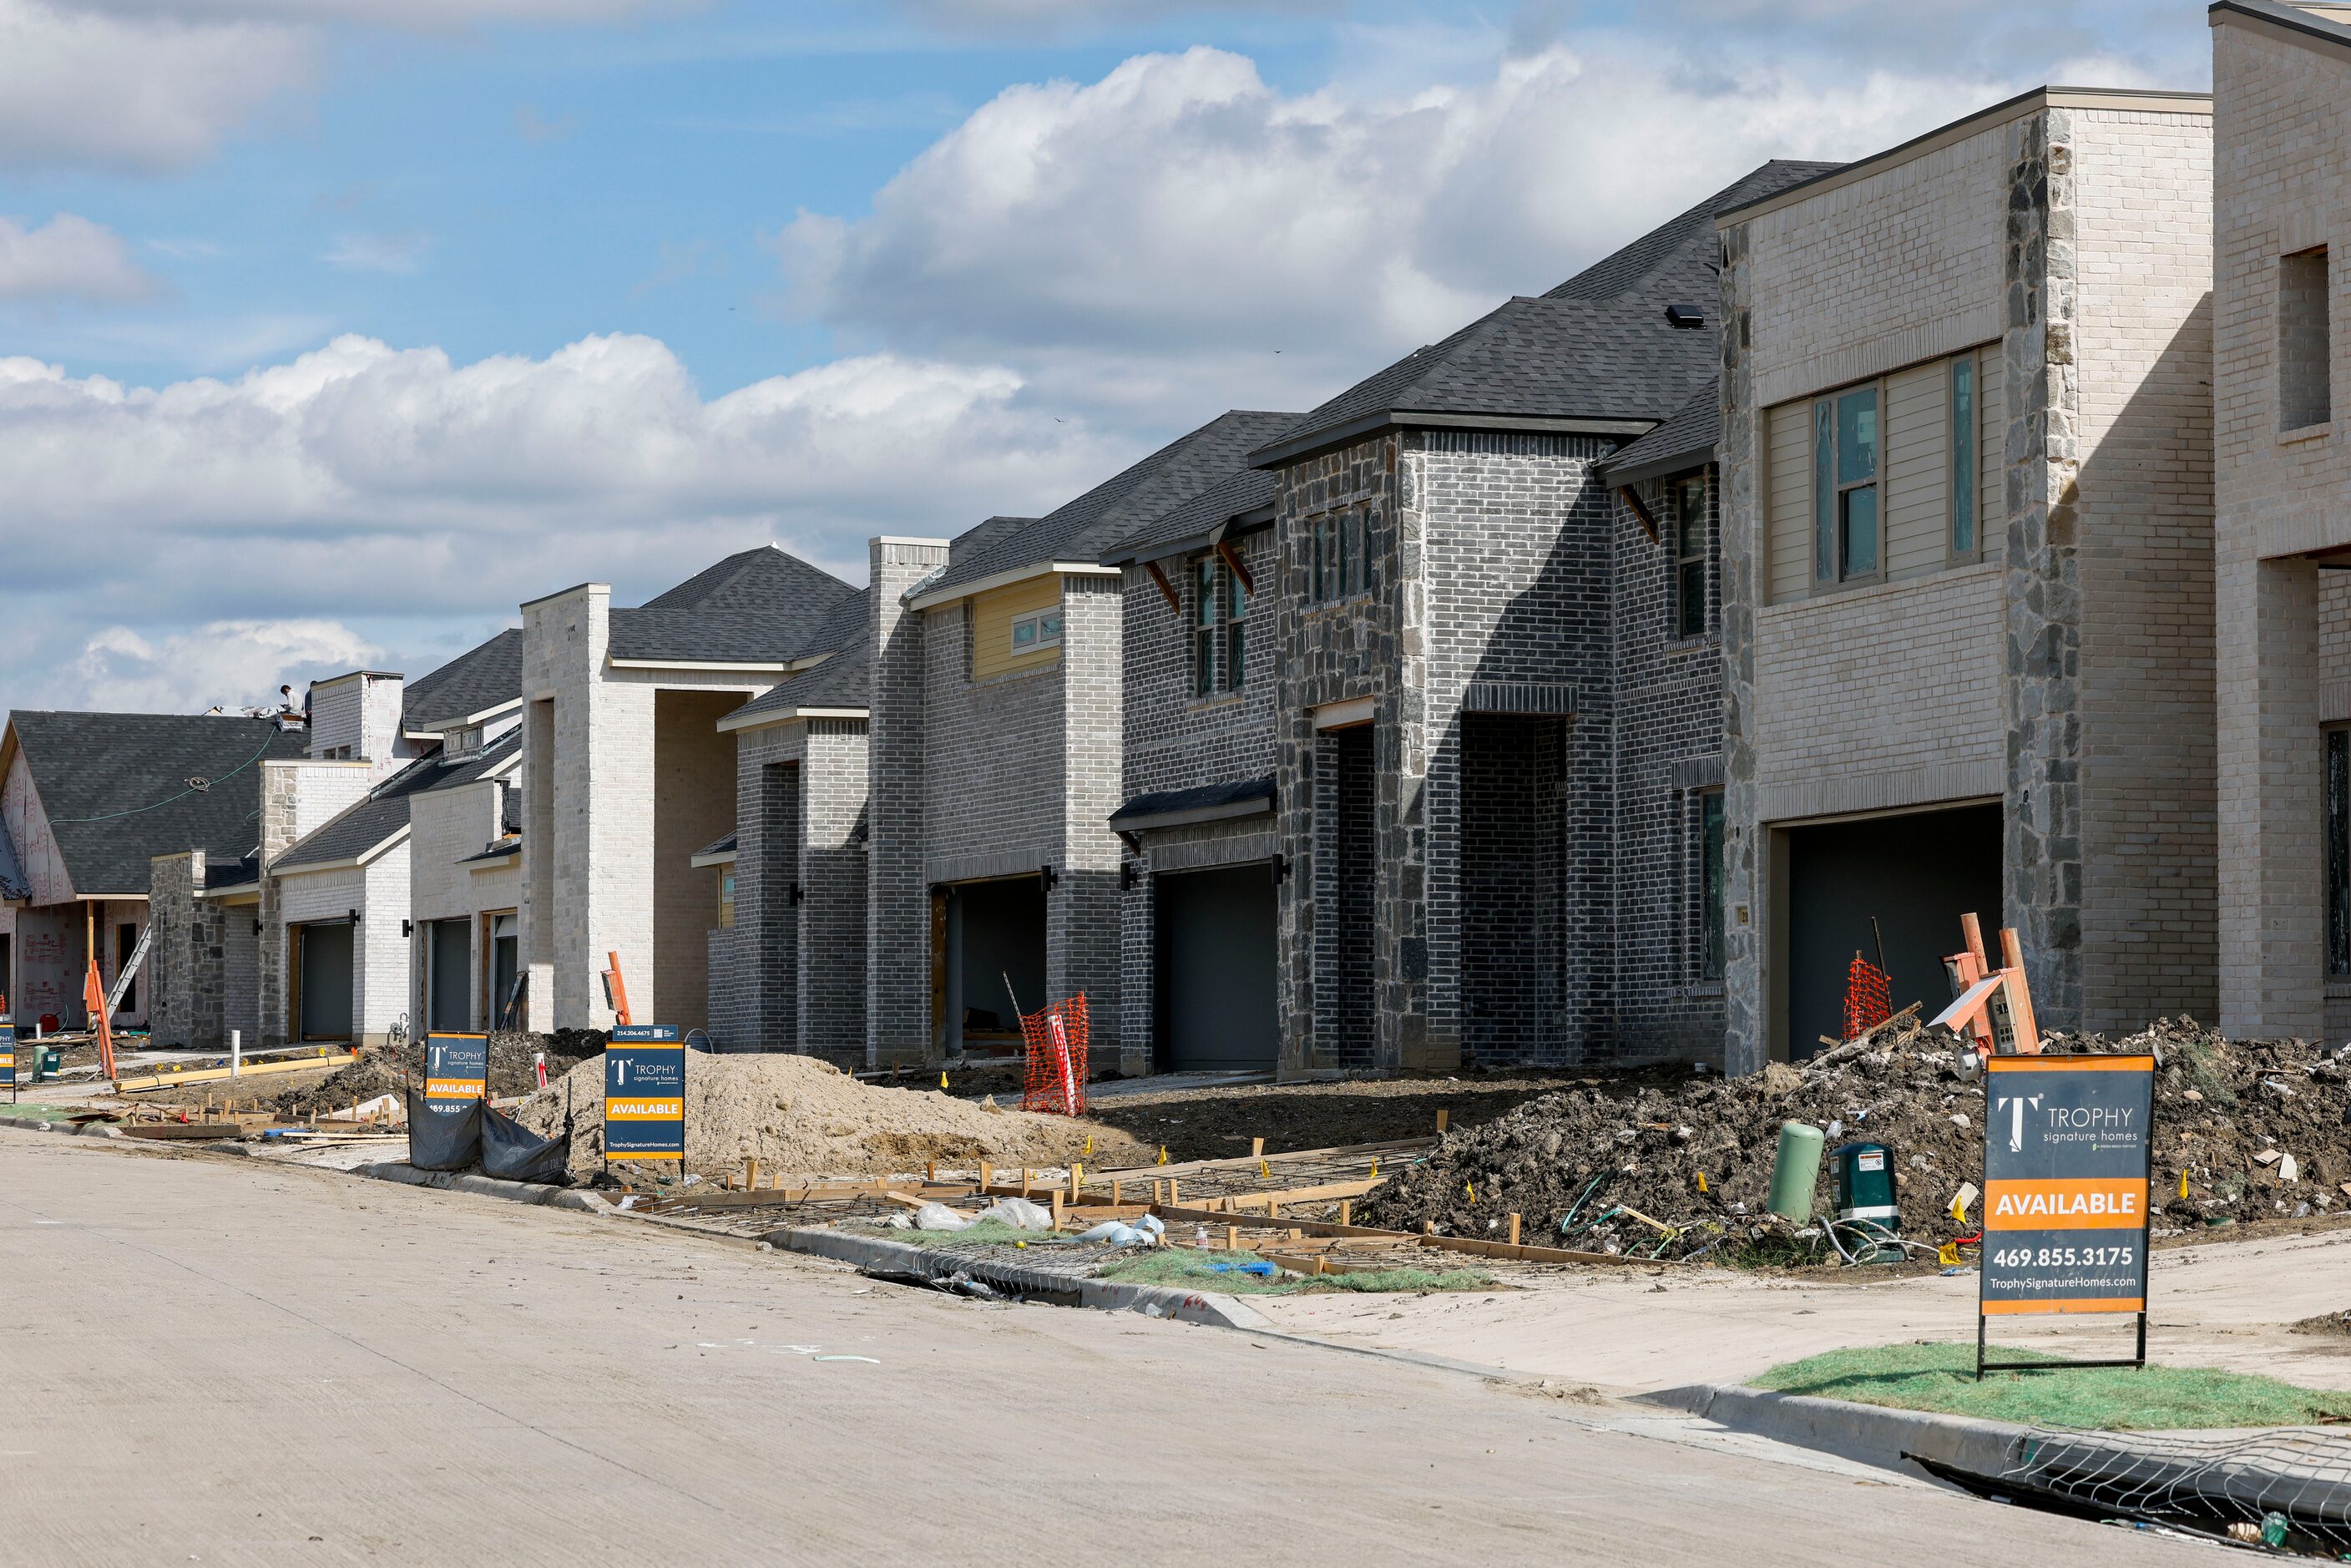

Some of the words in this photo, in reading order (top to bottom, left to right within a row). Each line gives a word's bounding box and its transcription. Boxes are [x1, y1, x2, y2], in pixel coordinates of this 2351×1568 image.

[448, 1051, 482, 1060] TROPHY
[635, 1065, 676, 1075] TROPHY
[428, 1084, 483, 1094] AVAILABLE
[611, 1104, 679, 1115] AVAILABLE
[2047, 1108, 2133, 1128] TROPHY
[2043, 1130, 2096, 1144] signature
[2101, 1129, 2138, 1141] homes
[1995, 1192, 2136, 1216] AVAILABLE
[1993, 1247, 2133, 1267] 469.855.3175
[1990, 1277, 2136, 1290] TrophySignatureHomes.com
